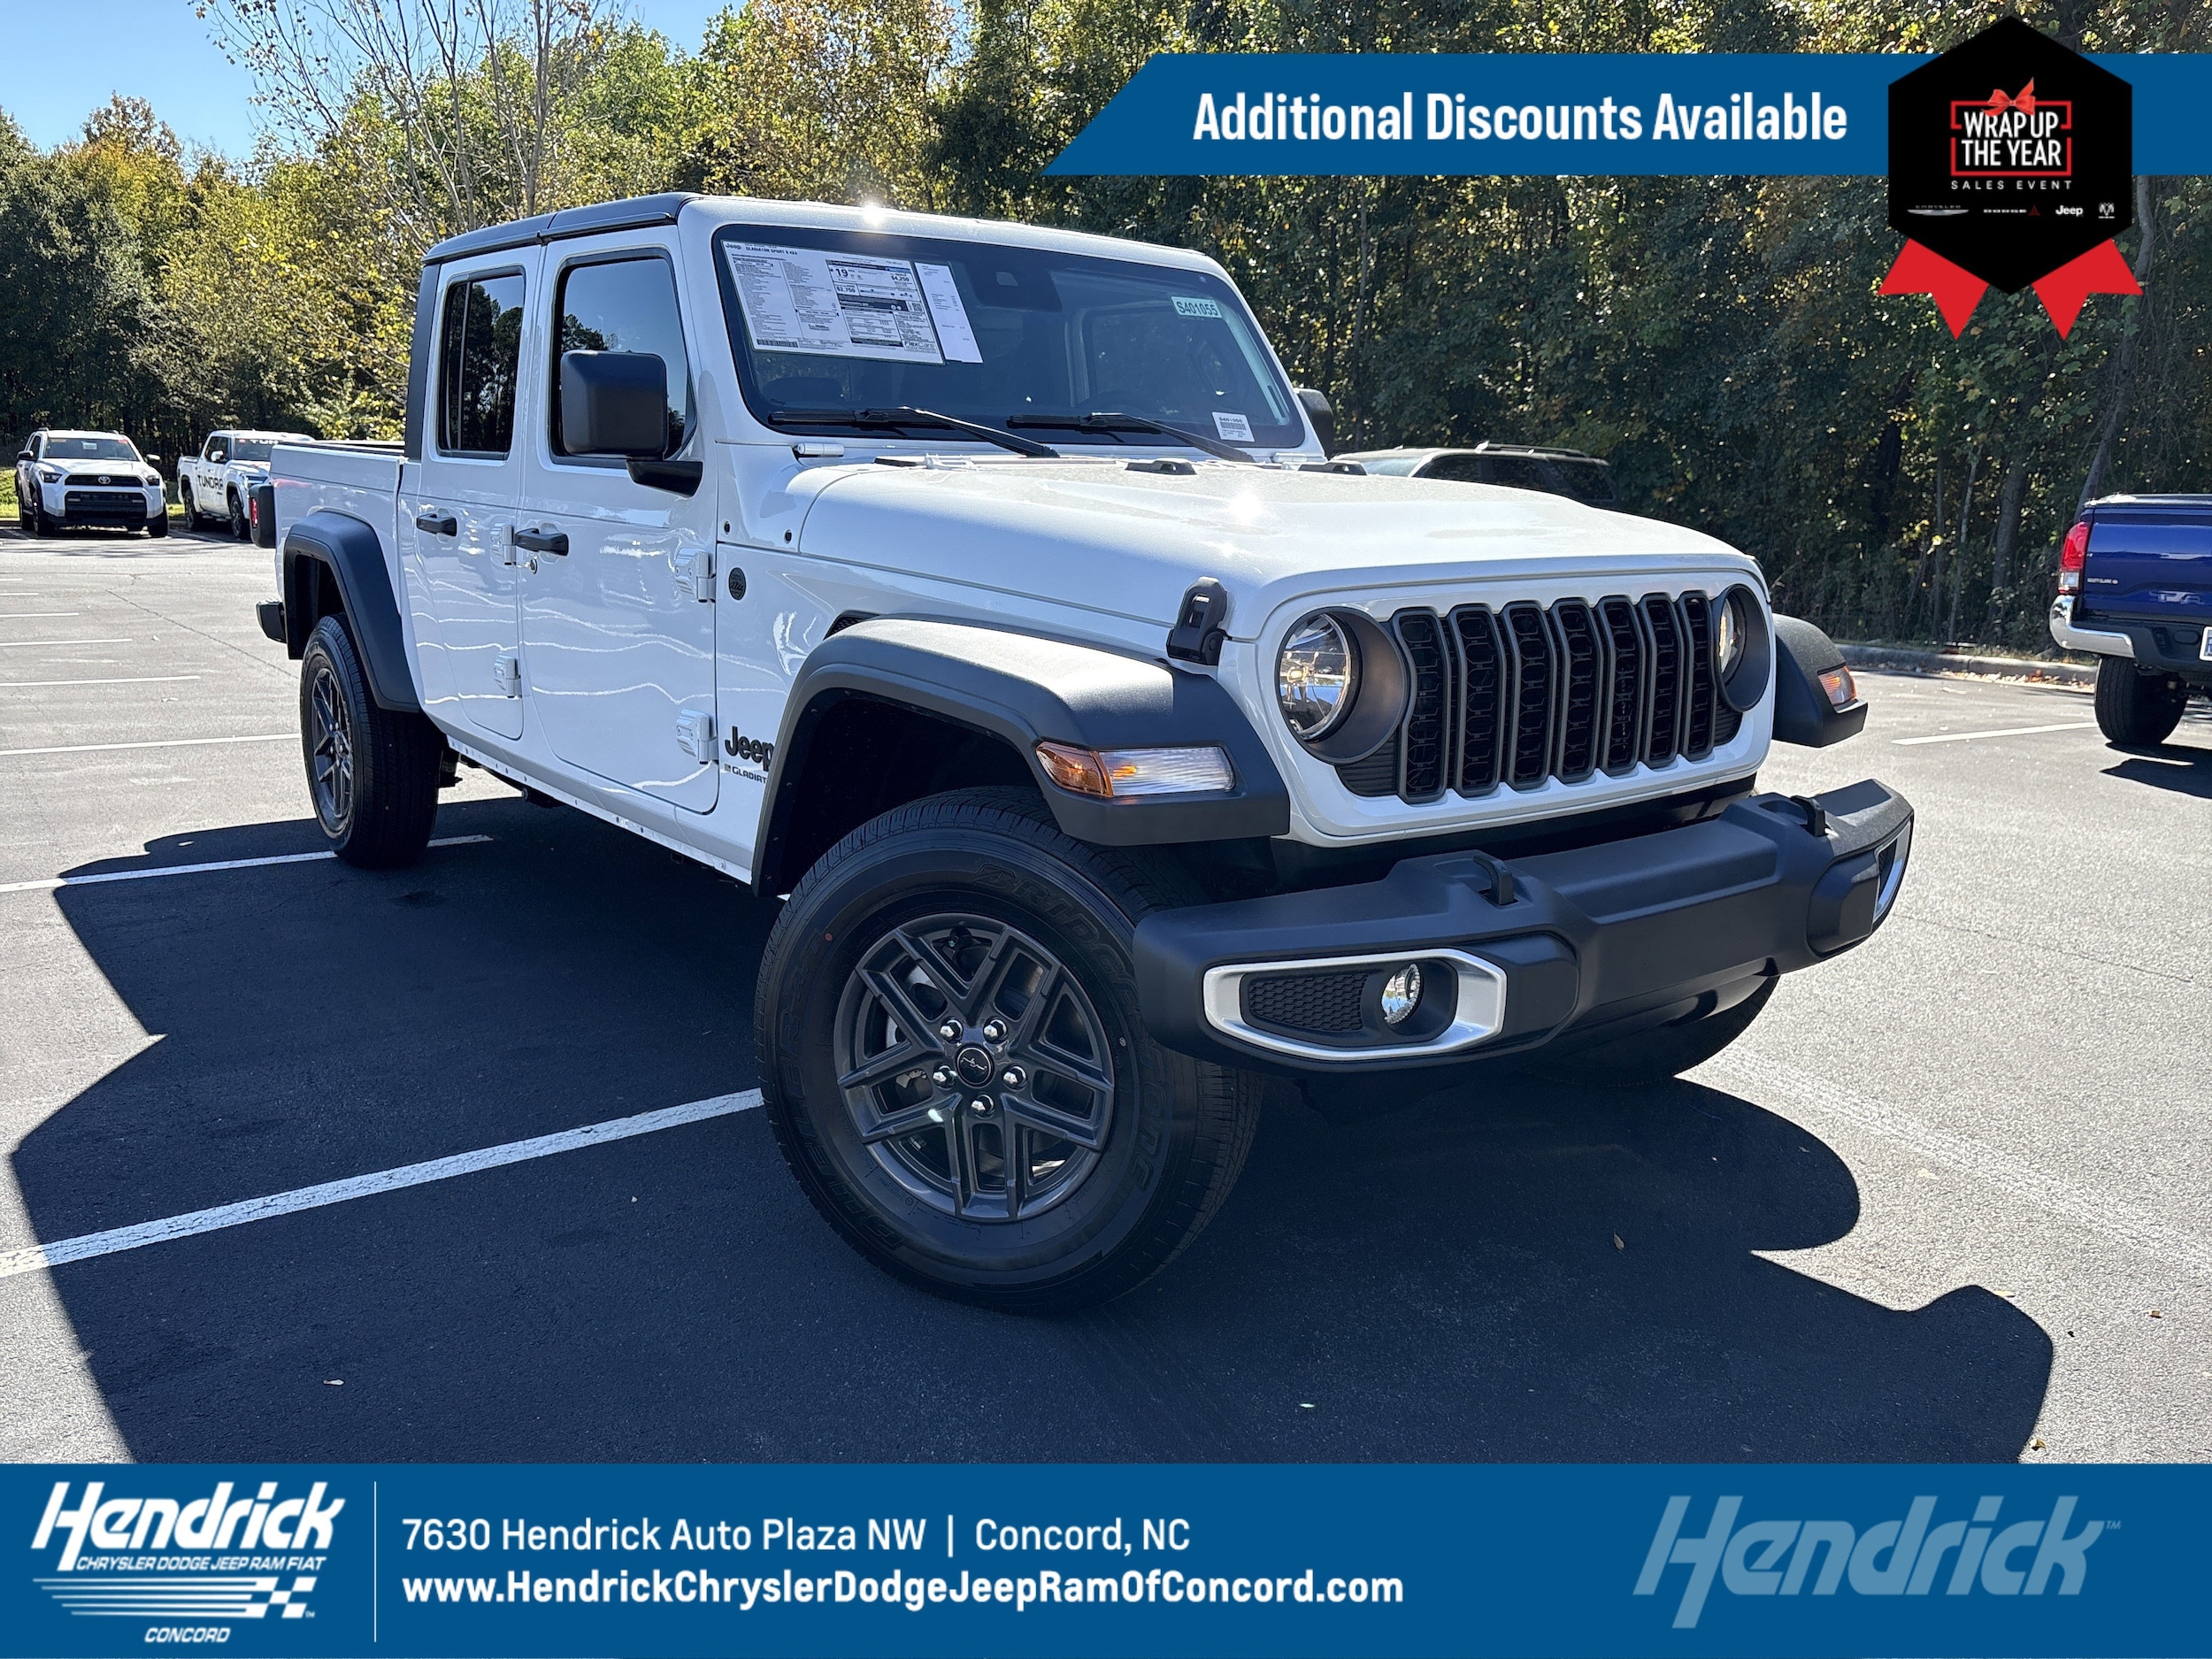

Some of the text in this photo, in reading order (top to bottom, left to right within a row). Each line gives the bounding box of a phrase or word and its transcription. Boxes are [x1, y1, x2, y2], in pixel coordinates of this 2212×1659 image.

[835, 268, 849, 278] 19
[1176, 301, 1219, 317] S401055
[196, 474, 224, 490] TUNDRA
[724, 725, 775, 772] Jeep
